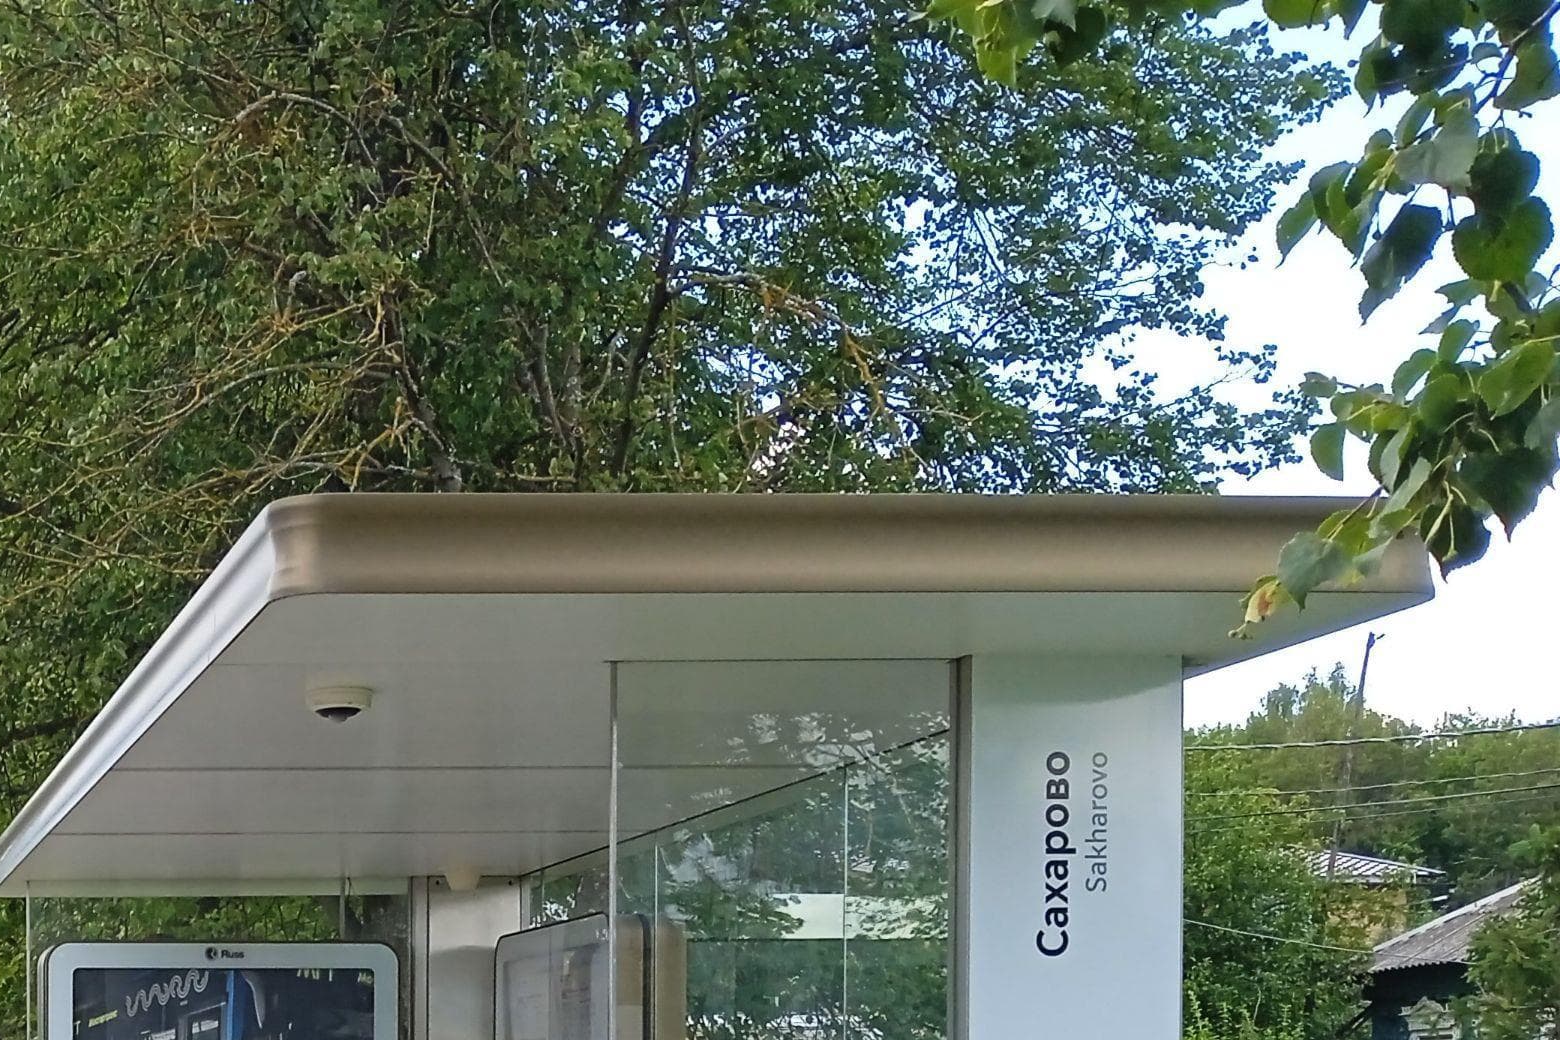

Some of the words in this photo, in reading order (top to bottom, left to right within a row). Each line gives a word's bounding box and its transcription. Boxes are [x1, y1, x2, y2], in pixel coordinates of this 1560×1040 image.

[1036, 751, 1077, 957] Сахарово
[1084, 751, 1108, 892] Sakharovo
[221, 949, 244, 959] Russ
